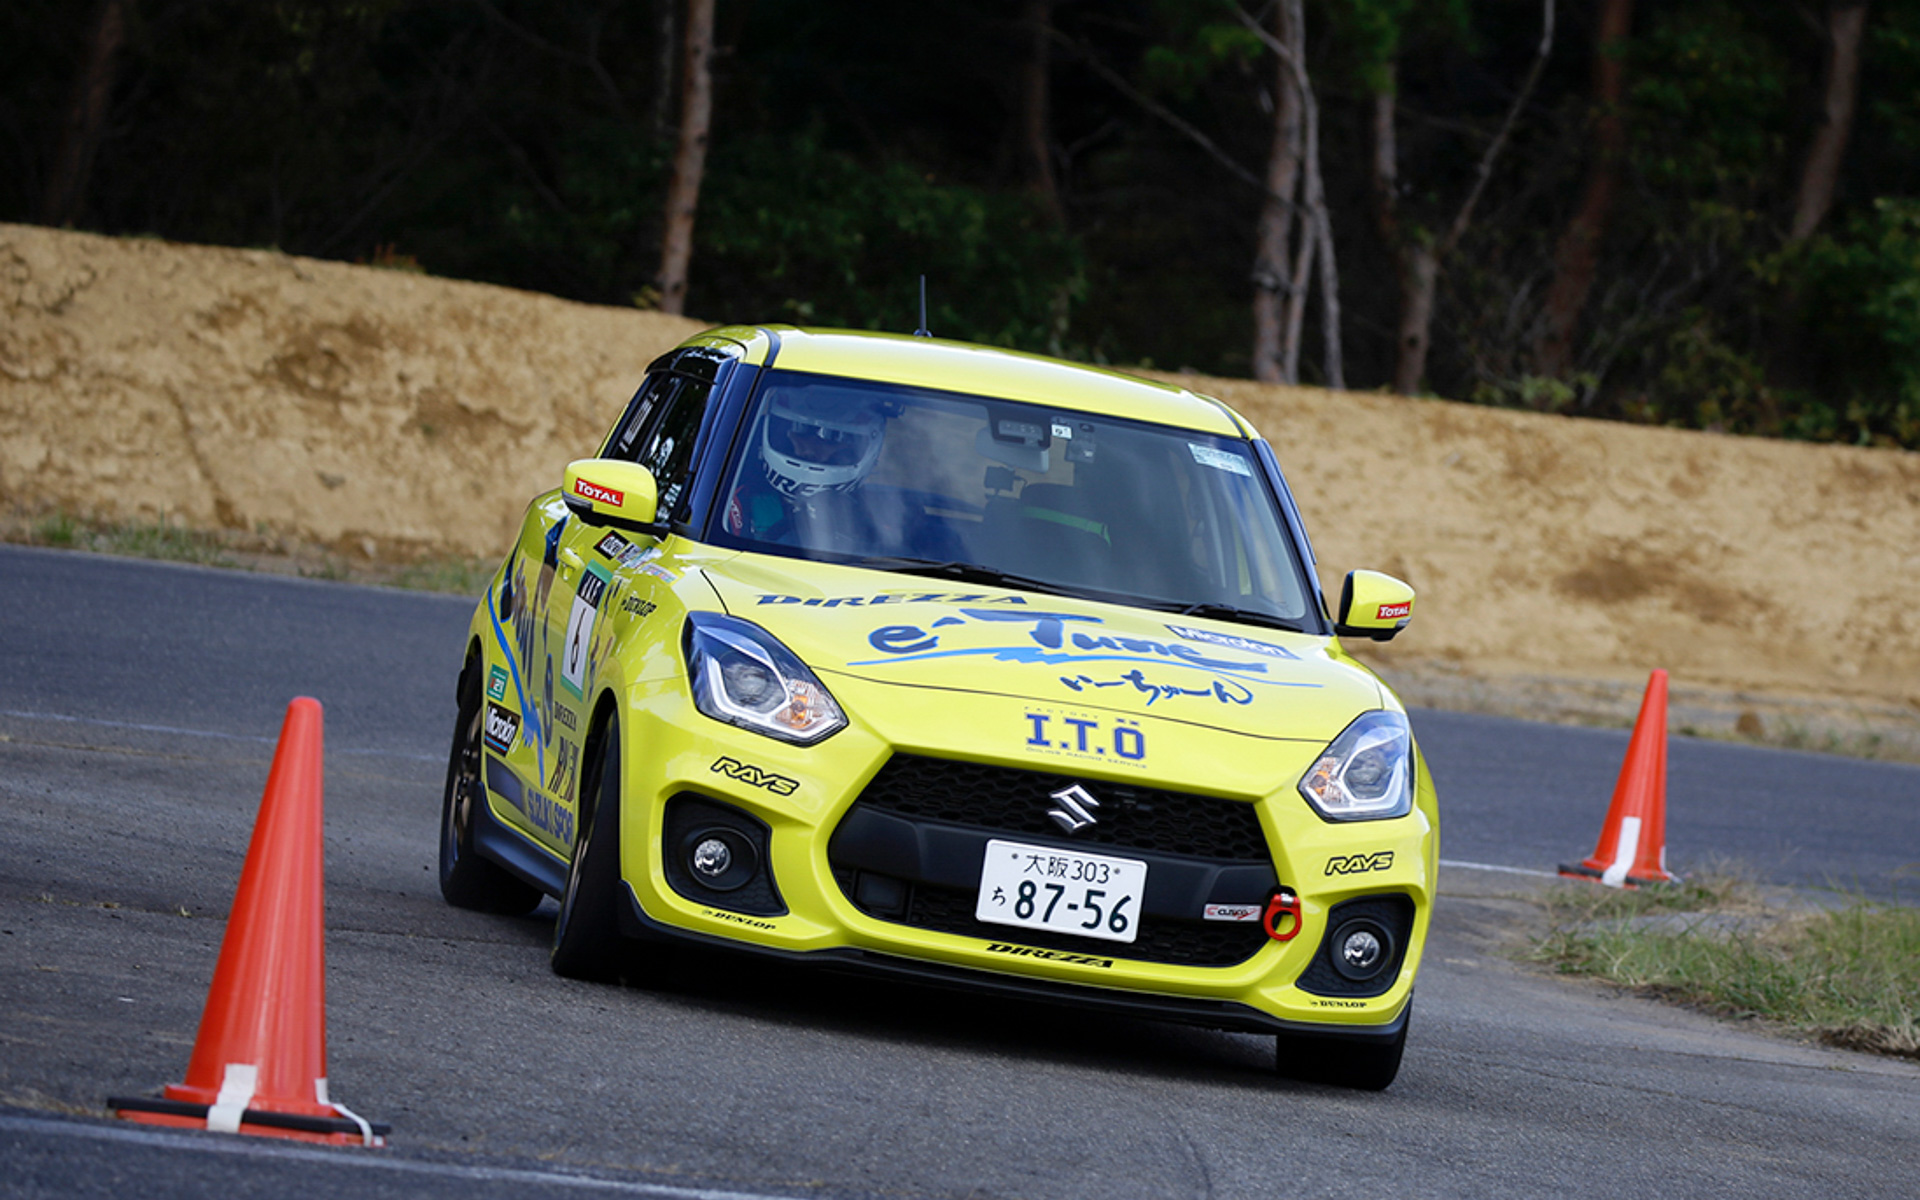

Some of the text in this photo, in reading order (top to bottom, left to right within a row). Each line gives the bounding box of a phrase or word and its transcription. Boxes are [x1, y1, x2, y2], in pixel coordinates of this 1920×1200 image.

[576, 480, 621, 505] TOTAL
[756, 593, 1027, 608] DIREZZA
[1380, 603, 1409, 617] TOTAL
[710, 756, 800, 797] RAYS
[1023, 854, 1111, 884] 大阪 303
[1324, 851, 1394, 876] RAYS
[991, 879, 1133, 934] ち 87-56
[714, 912, 776, 931] DUNLOP
[986, 943, 1114, 968] DIREZZA
[1319, 1000, 1367, 1009] DUNLOP
